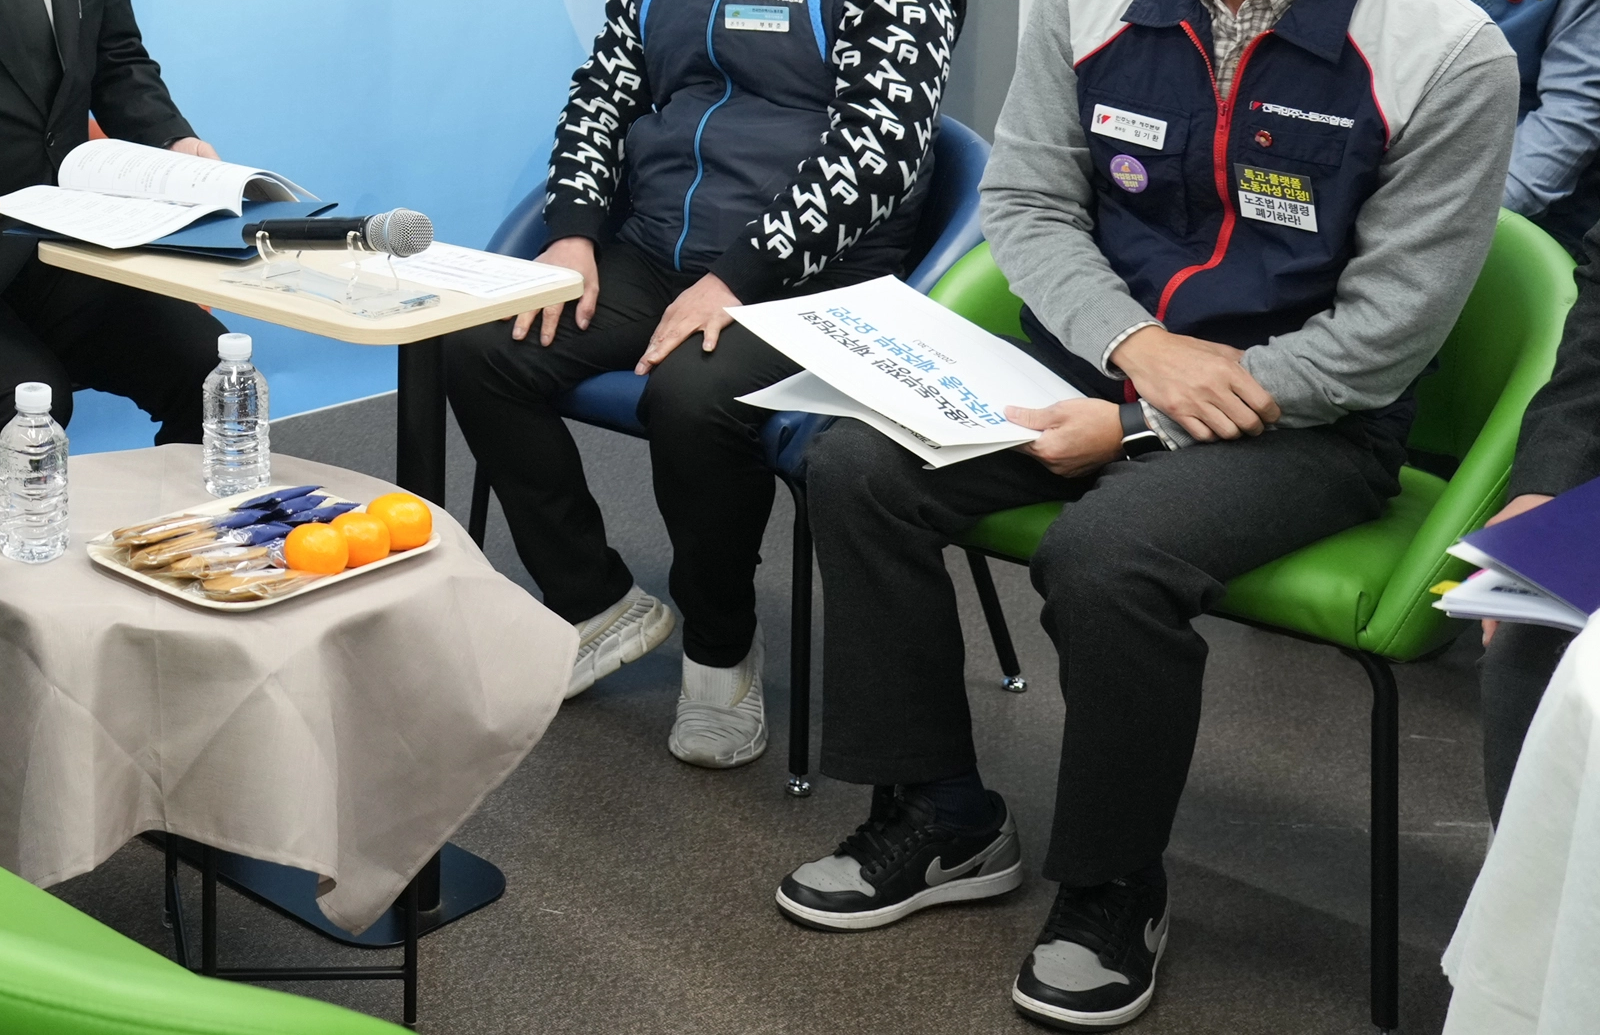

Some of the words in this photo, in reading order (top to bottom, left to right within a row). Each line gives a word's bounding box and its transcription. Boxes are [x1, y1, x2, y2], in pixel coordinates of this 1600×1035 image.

[1115, 115, 1136, 126] 민주노총
[1240, 180, 1283, 198] 노동자성
[1285, 188, 1310, 202] 인정!
[1244, 195, 1276, 211] 노조법
[1278, 203, 1310, 217] 시행령
[1254, 207, 1302, 226] 폐기하라!
[797, 310, 873, 358] 제주간담회
[824, 306, 878, 334] 요구안
[872, 335, 940, 374] 제주본부
[870, 359, 986, 428] 고용노동부장관
[937, 375, 1006, 426] 민주노총
